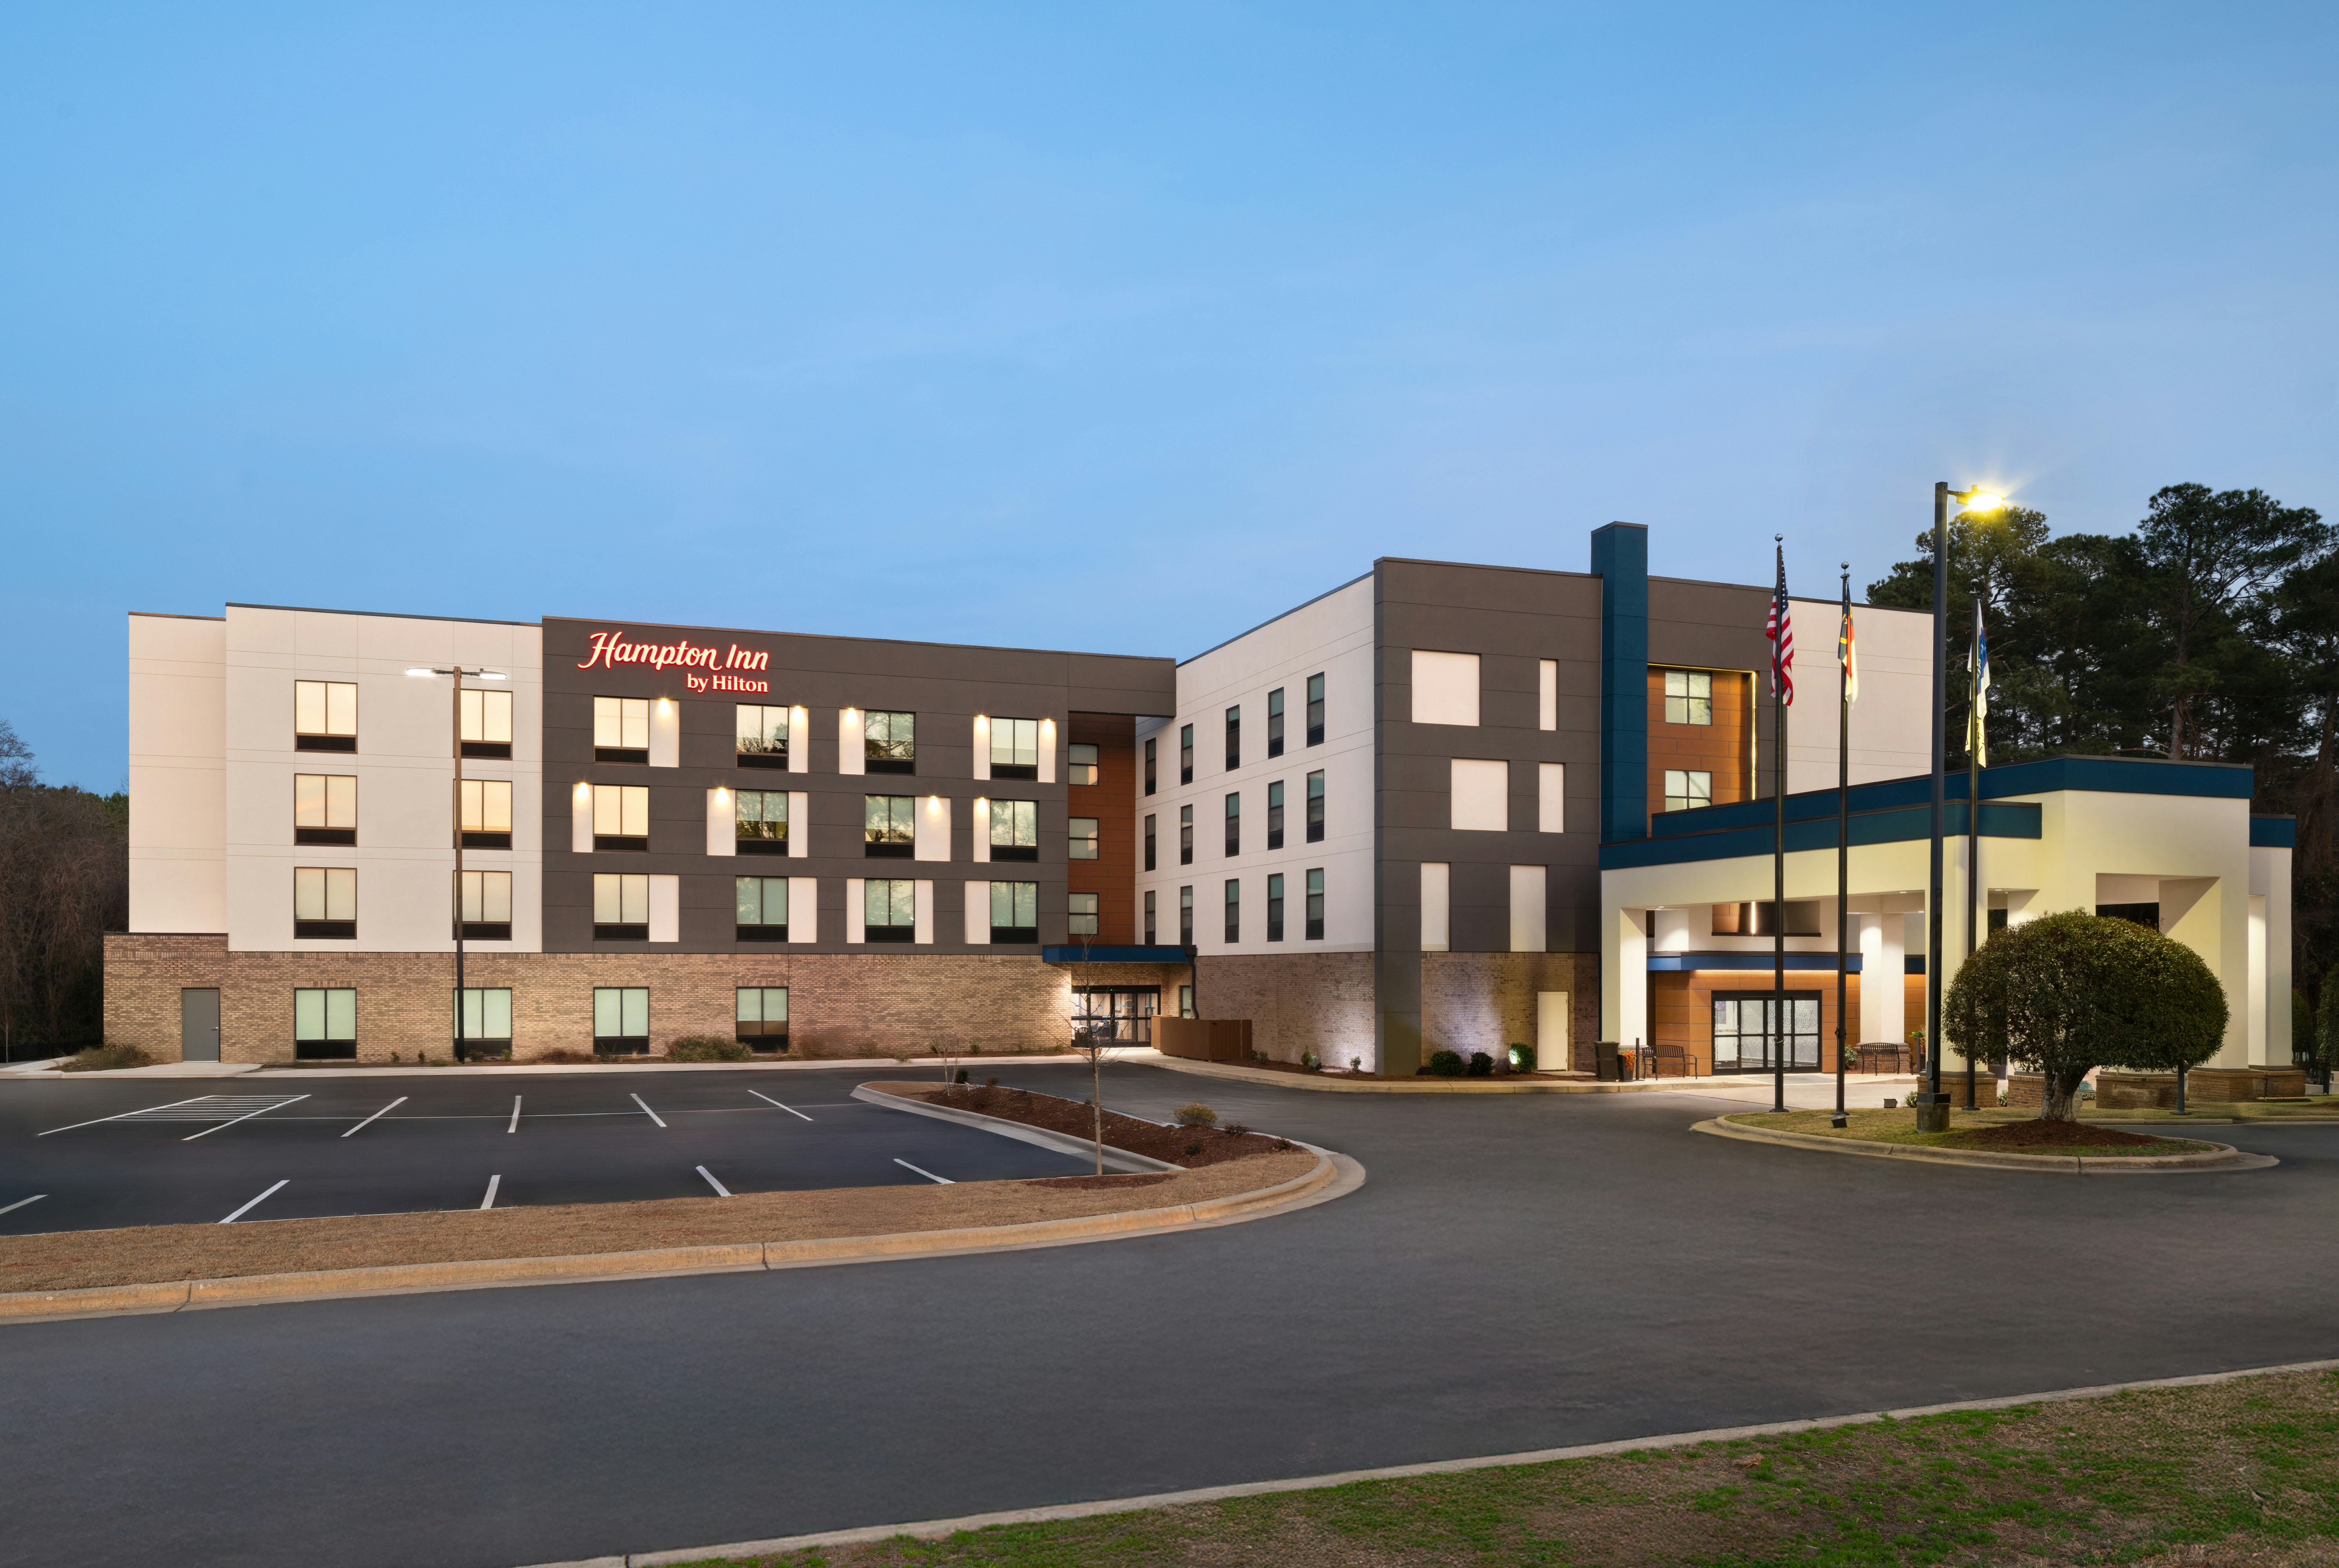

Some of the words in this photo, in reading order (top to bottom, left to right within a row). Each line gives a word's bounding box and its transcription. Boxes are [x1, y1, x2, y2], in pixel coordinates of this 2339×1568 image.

[577, 631, 722, 670] Hampton
[725, 644, 768, 670] Inn
[687, 673, 709, 693] by
[712, 675, 768, 692] Hilton
[1799, 1017, 1810, 1027] US
